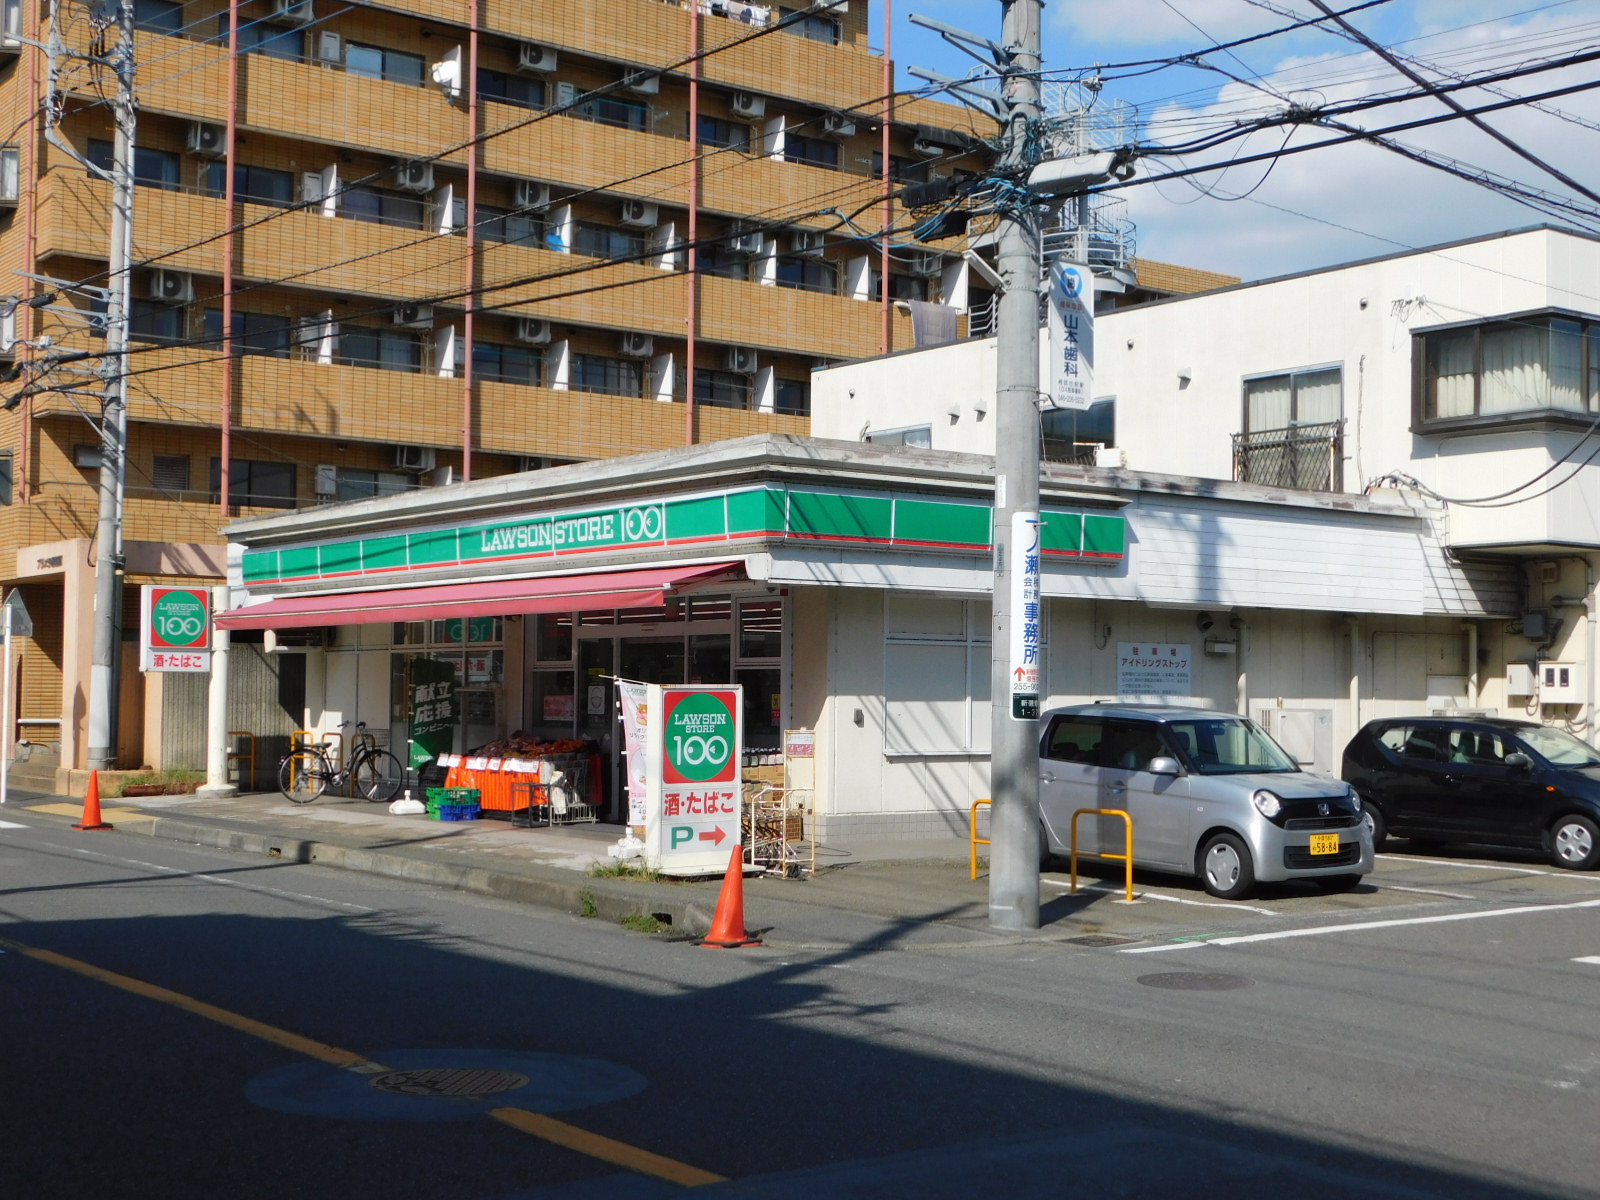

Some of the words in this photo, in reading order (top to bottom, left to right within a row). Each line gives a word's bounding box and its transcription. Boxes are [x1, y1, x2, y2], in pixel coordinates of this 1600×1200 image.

[1063, 313, 1079, 378] 山本歯科
[481, 523, 553, 552] LAWSON
[554, 515, 614, 544] STORE
[618, 505, 662, 542] 100
[159, 602, 200, 611] LAWSON
[158, 616, 201, 636] 100
[1023, 601, 1039, 665] 事務所
[415, 681, 452, 704] 献立
[414, 701, 452, 725] 応援
[674, 713, 726, 725] LAWSON
[685, 724, 715, 733] STORE
[673, 735, 728, 766] 100
[664, 791, 734, 817] 酒・たばこ
[671, 826, 694, 850] P
